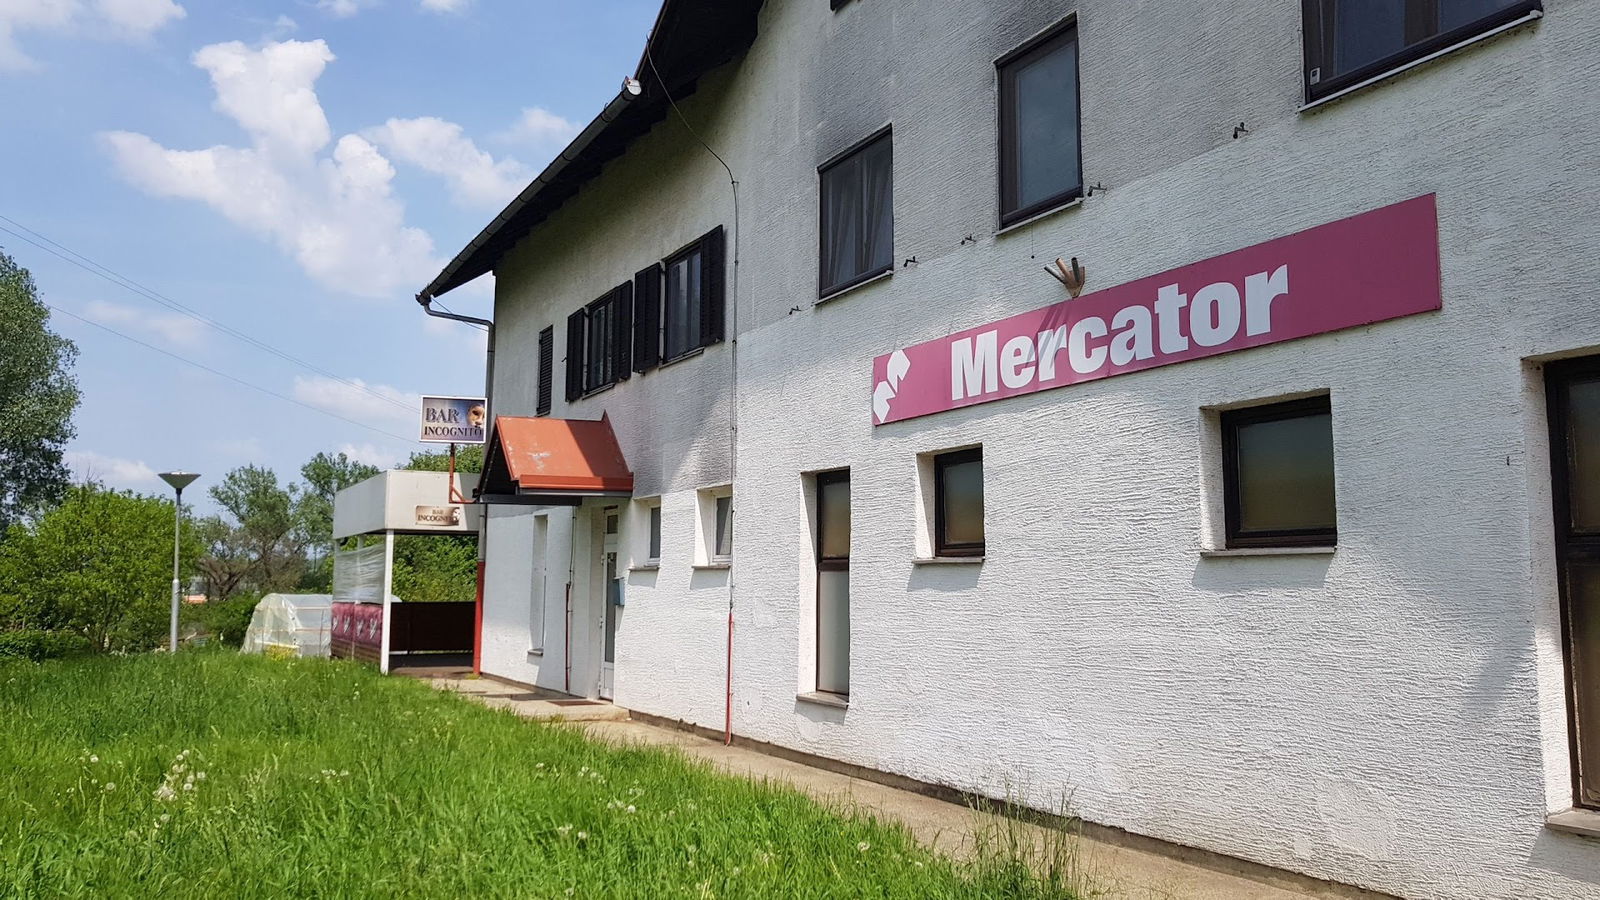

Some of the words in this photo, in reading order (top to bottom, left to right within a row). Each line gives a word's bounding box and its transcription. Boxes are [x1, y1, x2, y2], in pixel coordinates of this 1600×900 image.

[951, 264, 1289, 401] Mercator
[425, 407, 460, 424] BAR
[424, 426, 482, 437] INCOGNITO
